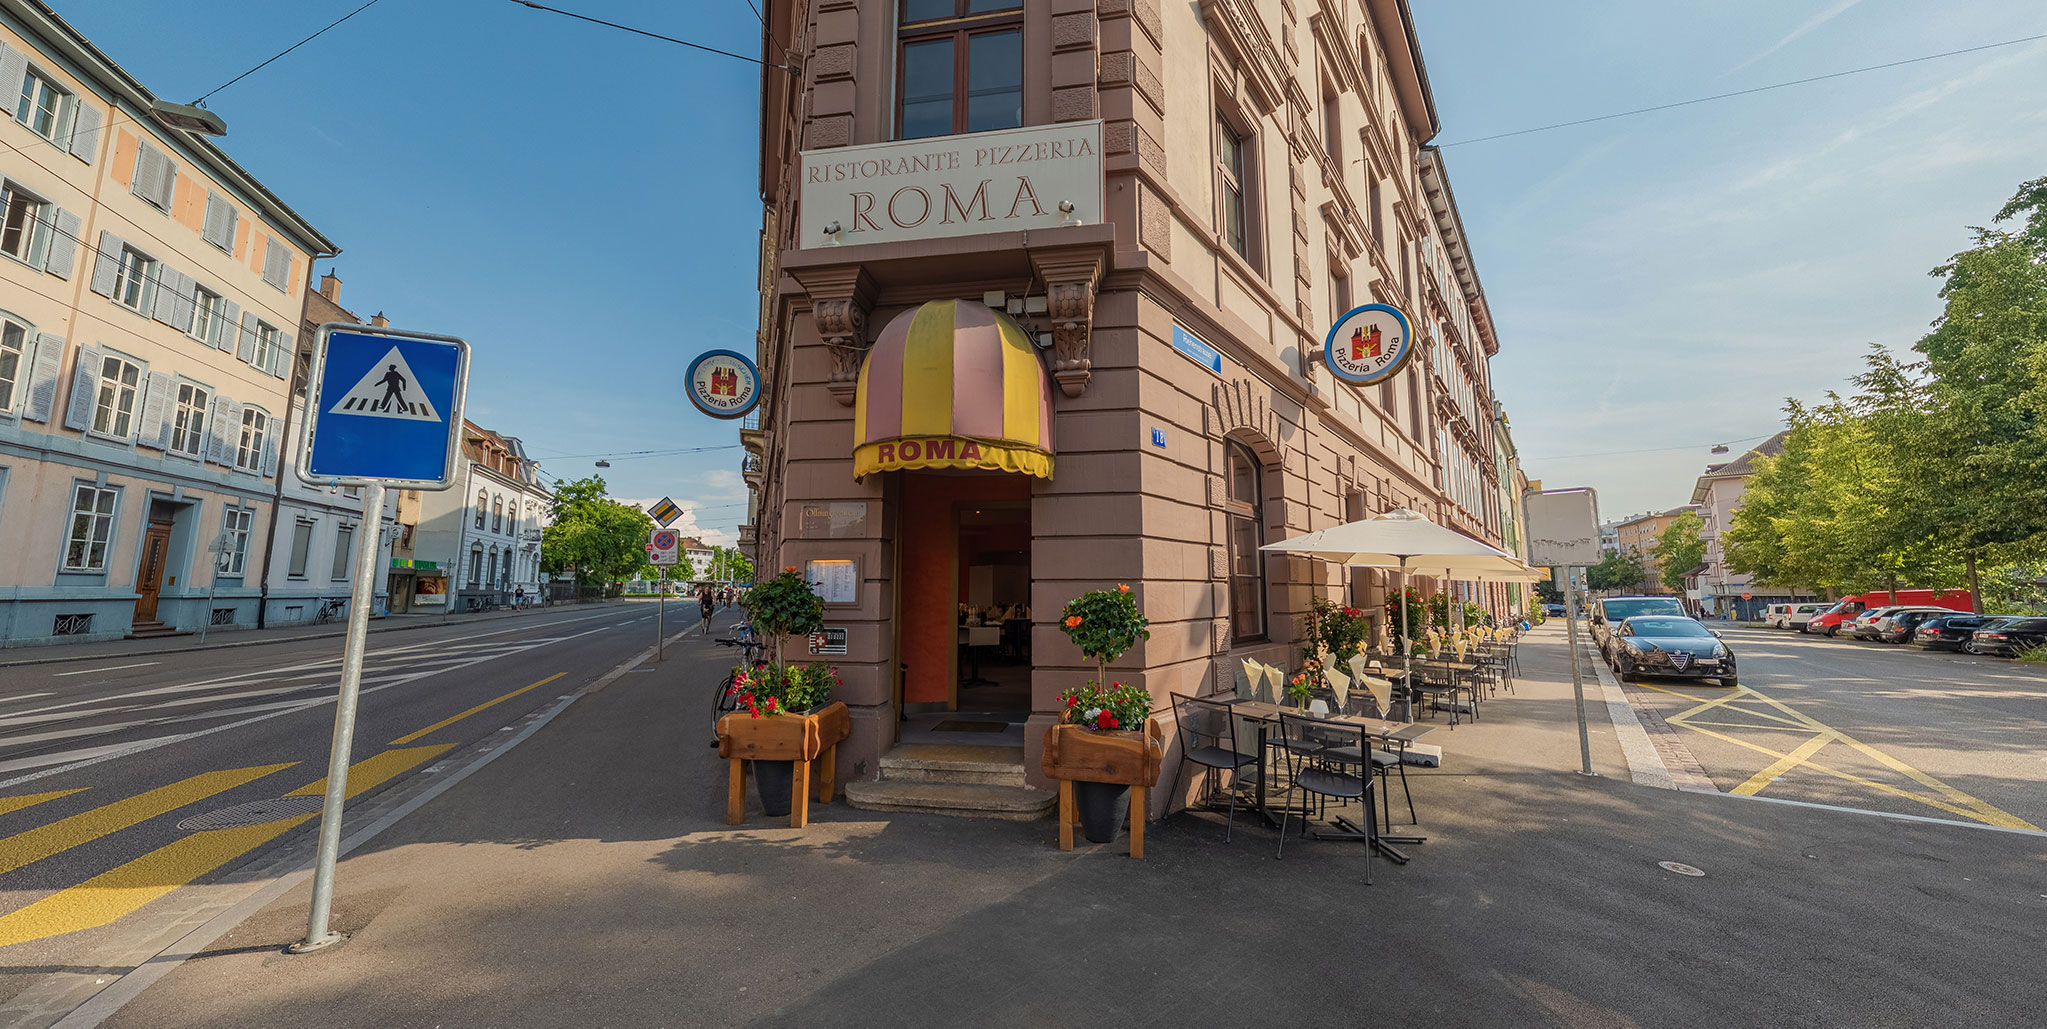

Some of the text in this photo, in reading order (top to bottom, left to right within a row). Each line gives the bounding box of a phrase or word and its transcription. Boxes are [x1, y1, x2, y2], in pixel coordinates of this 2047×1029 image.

[808, 137, 1096, 184] RISTORANTE PIZZERIA
[848, 175, 1049, 233] ROMA
[1335, 336, 1400, 373] Pizzeria Roma
[696, 380, 751, 408] Pizzeria Roma
[878, 439, 982, 464] ROMA
